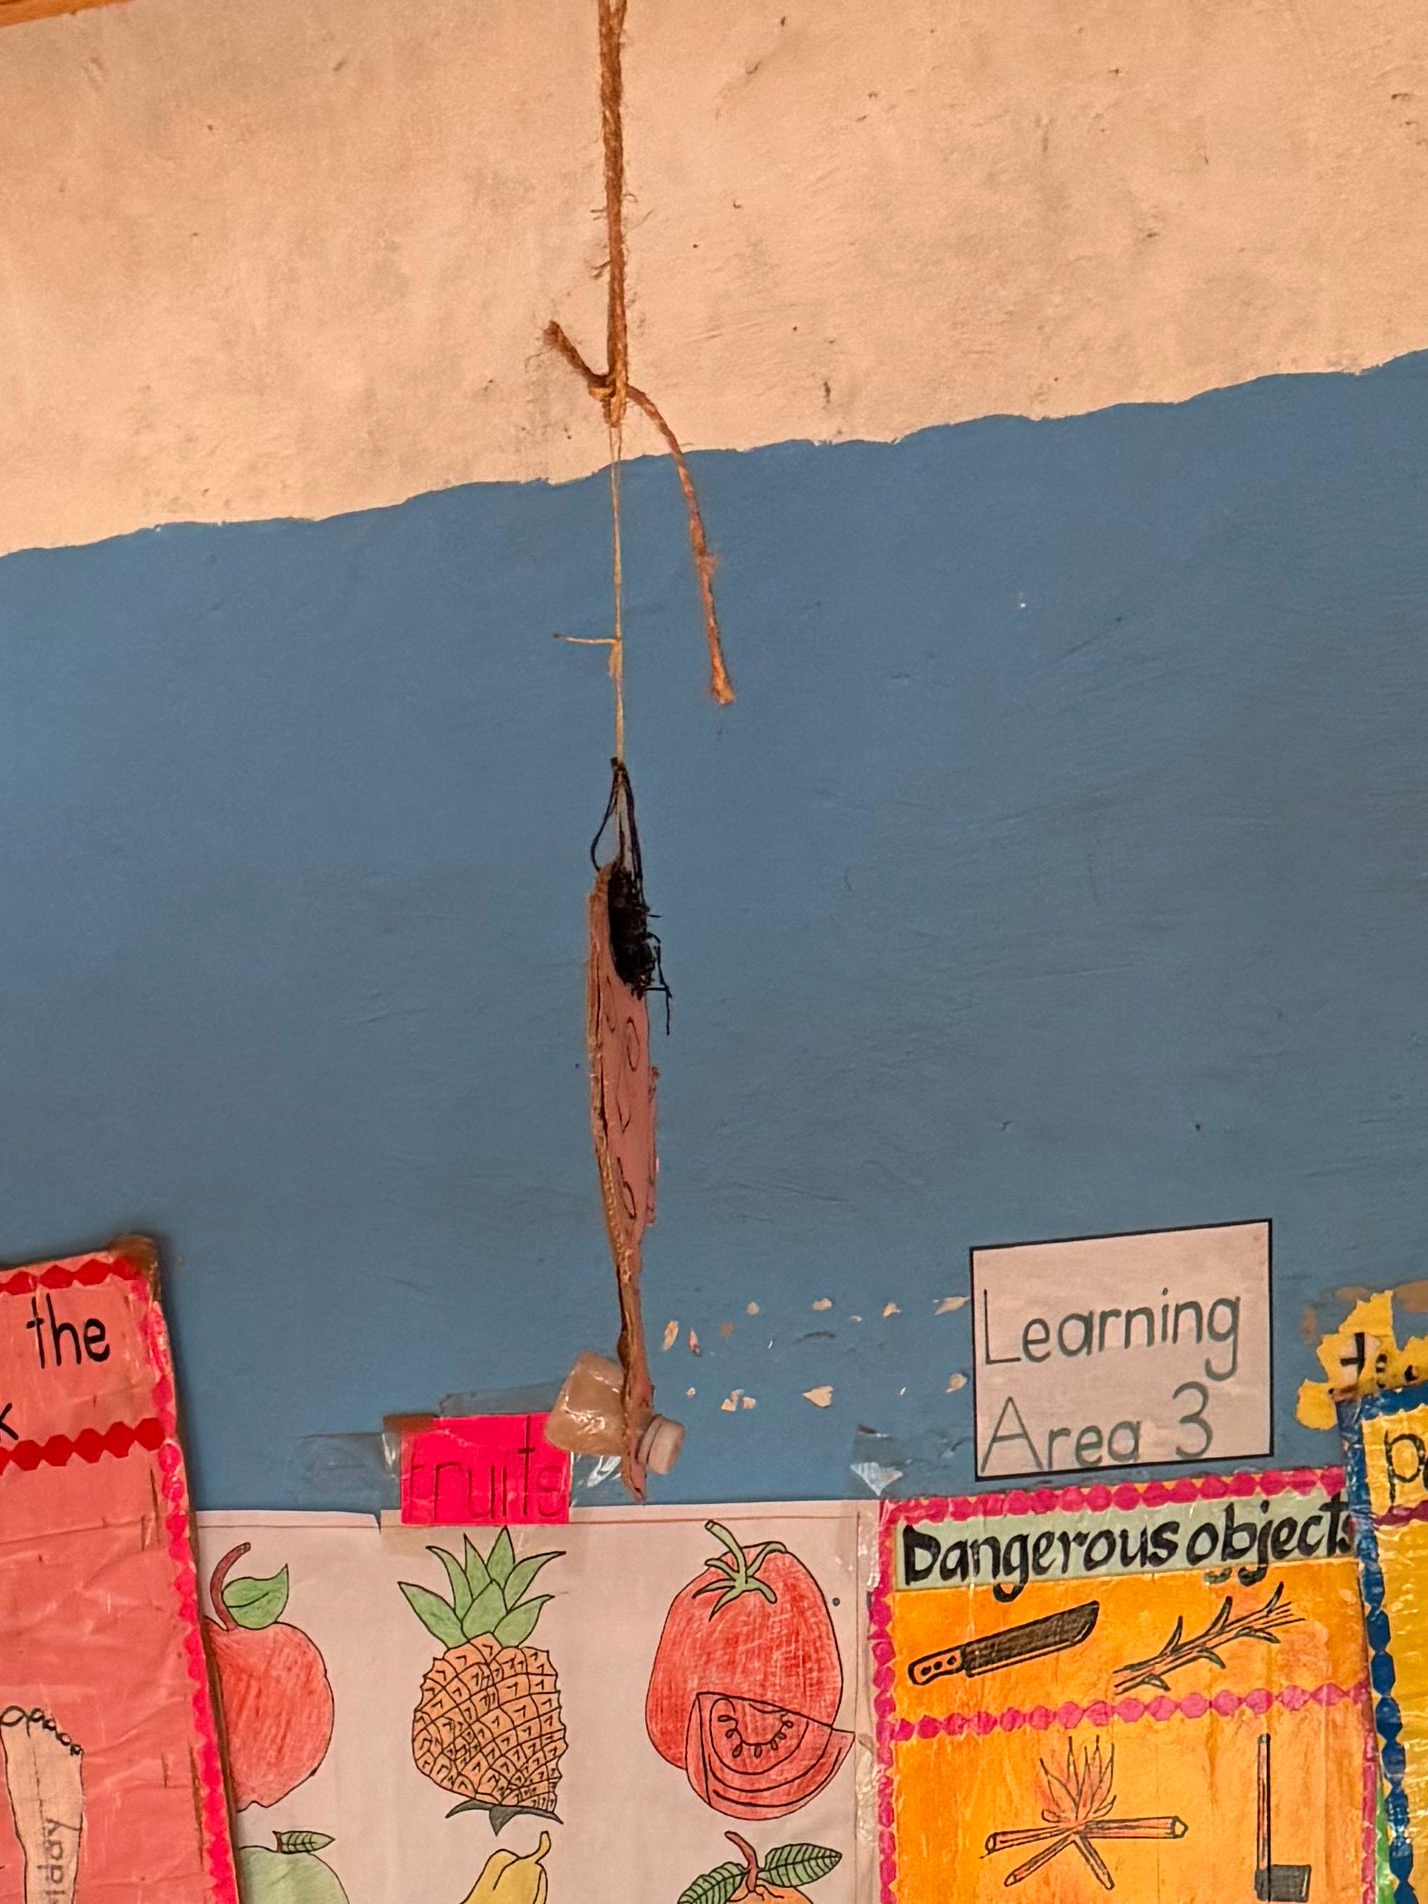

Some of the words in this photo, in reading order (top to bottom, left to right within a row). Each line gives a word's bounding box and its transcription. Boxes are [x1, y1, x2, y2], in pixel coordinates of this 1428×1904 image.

[26, 1294, 111, 1371] the
[982, 1287, 1241, 1382] Learning
[980, 1396, 1142, 1472] Area
[1172, 1381, 1214, 1462] 3
[902, 1508, 1180, 1602] Dangerous
